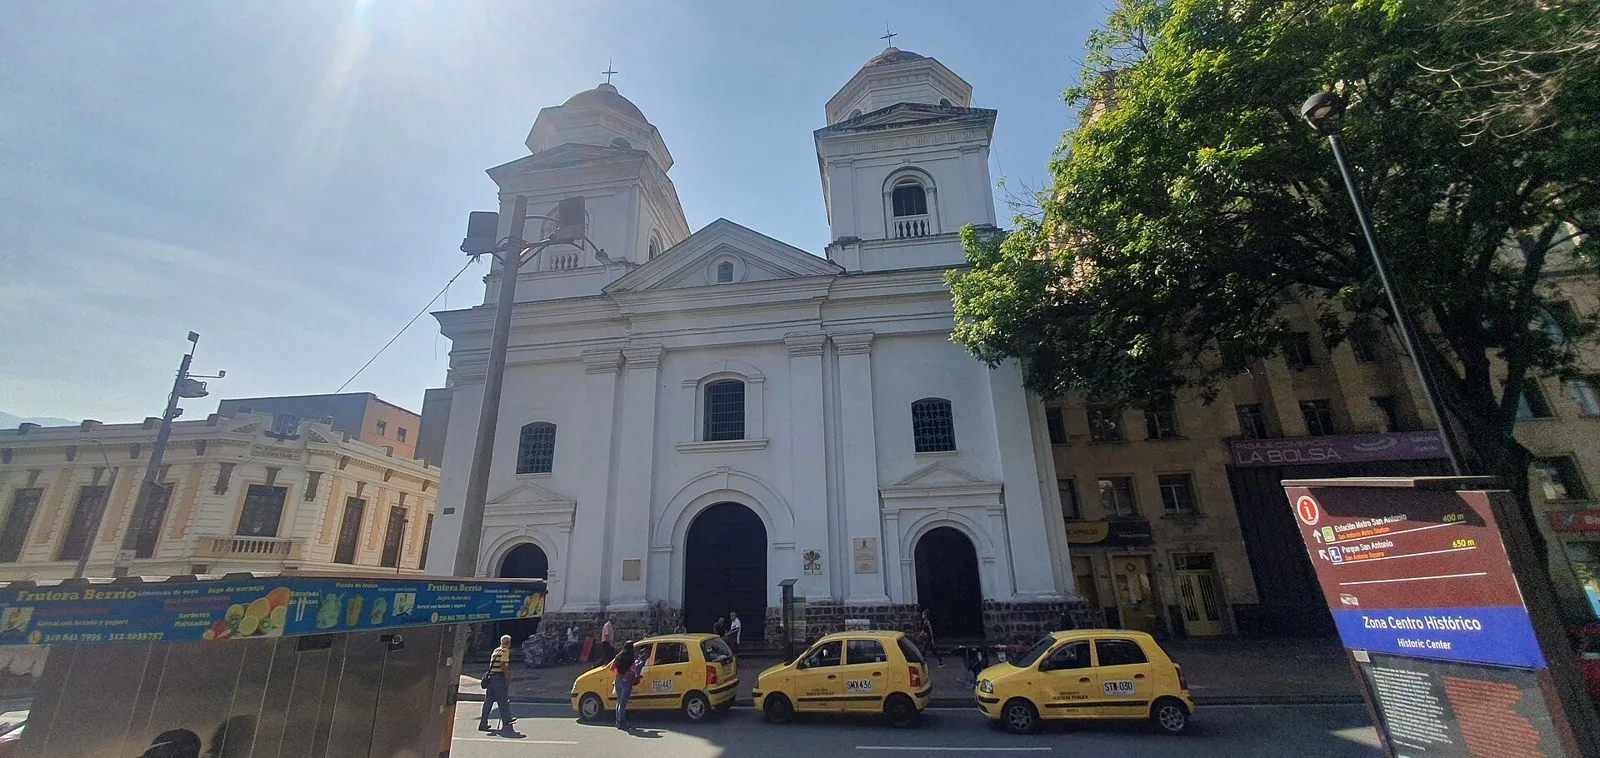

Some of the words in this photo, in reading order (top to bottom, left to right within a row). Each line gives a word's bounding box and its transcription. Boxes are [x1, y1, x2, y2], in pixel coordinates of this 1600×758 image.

[1274, 439, 1335, 449] COMERCIAL
[1237, 451, 1264, 464] LA
[1267, 448, 1342, 462] BOLSA
[1334, 523, 1356, 532] Estación
[1356, 520, 1371, 530] Metro
[1371, 518, 1383, 526] San
[1384, 514, 1407, 524] Antonio
[1443, 514, 1456, 522] 400
[1342, 545, 1360, 554] Parque
[1372, 540, 1394, 549] Antonio
[1452, 540, 1466, 548] 650
[208, 586, 224, 594] Jugo
[427, 584, 459, 592] Frutera
[16, 590, 79, 601] Frutera
[83, 588, 137, 600] Berrío
[1362, 616, 1388, 629] Zona
[1388, 616, 1424, 630] Centro
[1424, 616, 1482, 631] Histórico
[1397, 638, 1425, 649] Historic
[1426, 640, 1451, 650] Center
